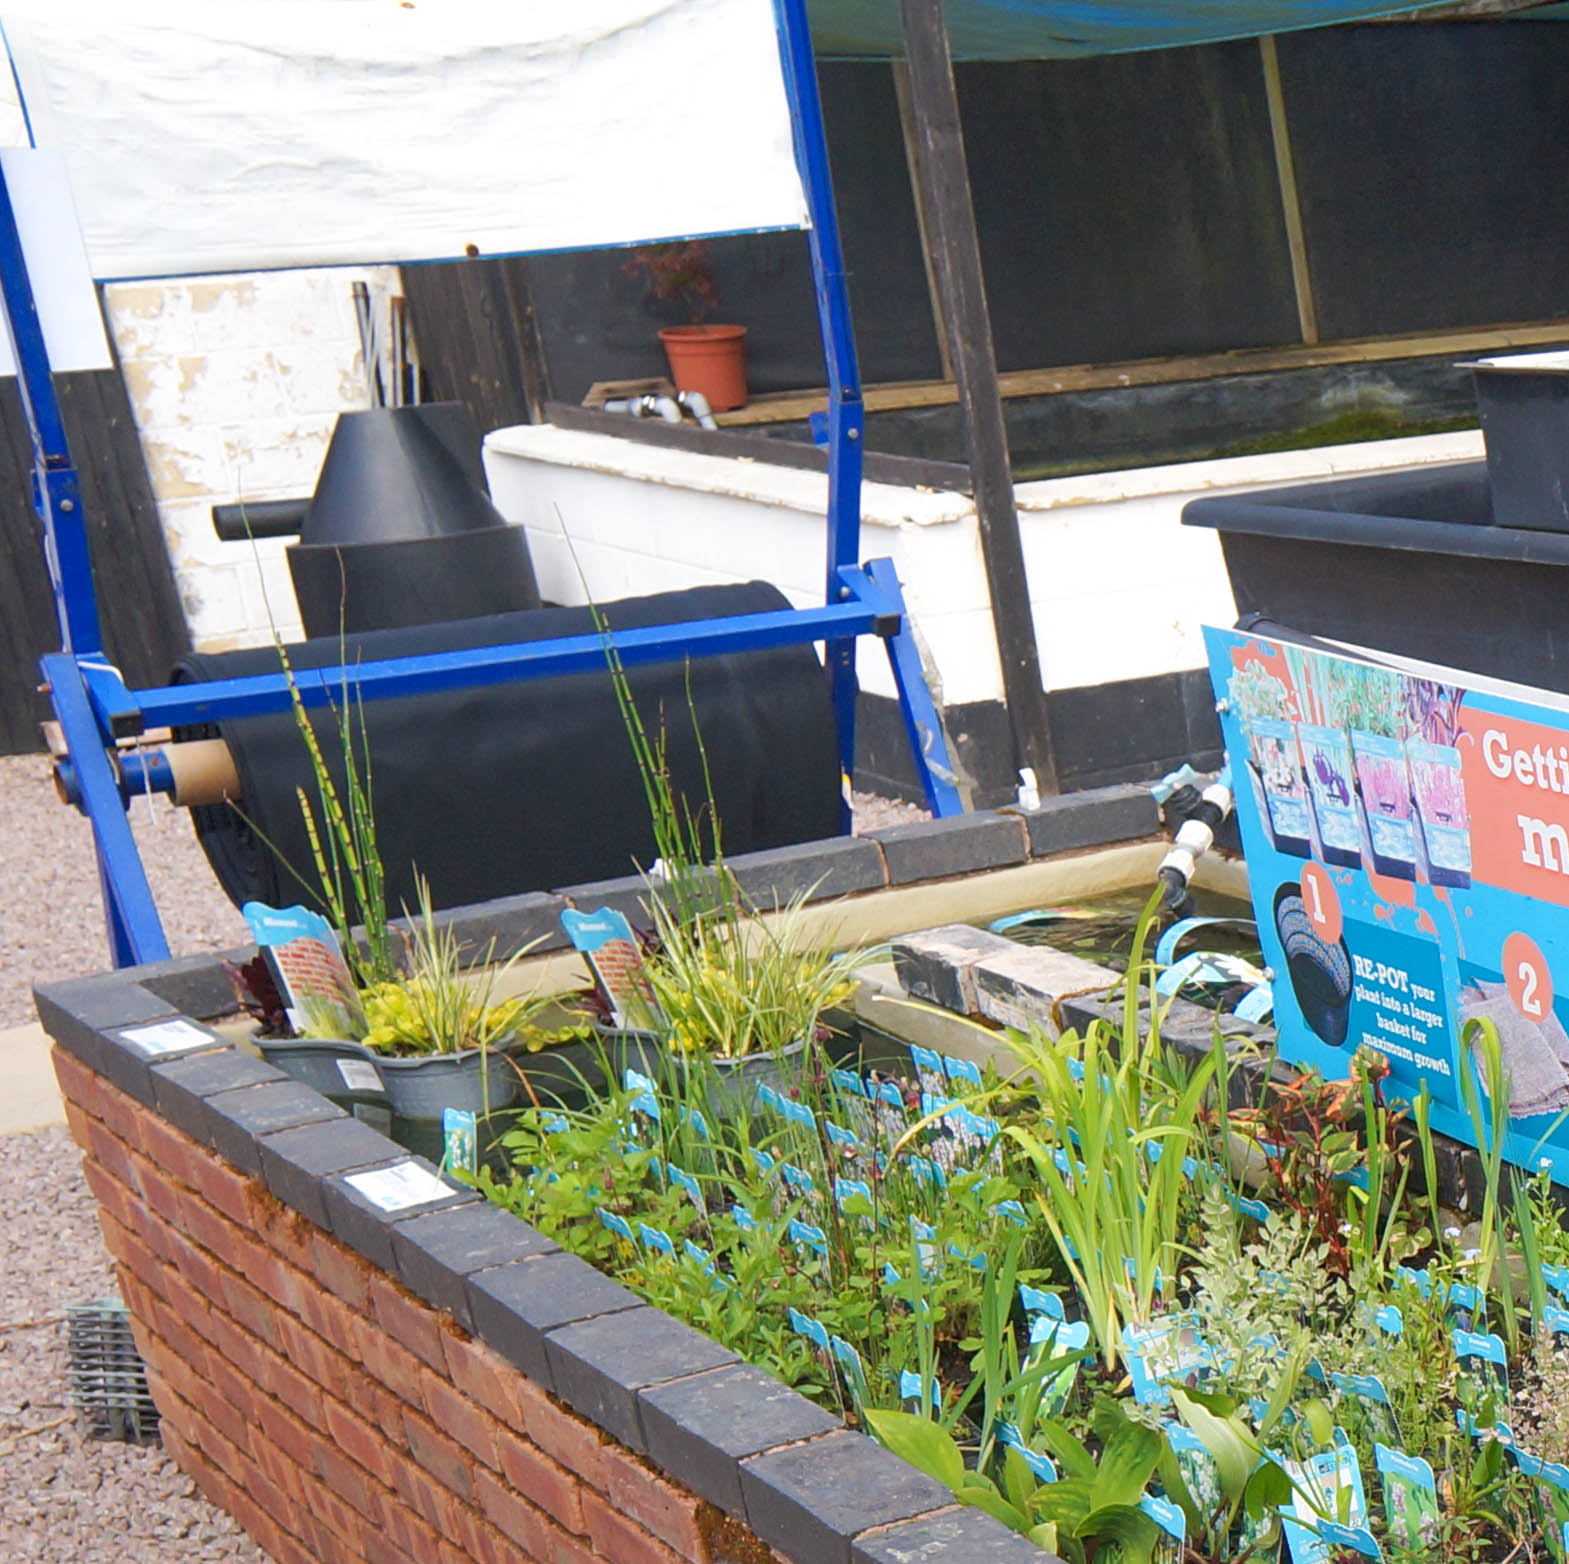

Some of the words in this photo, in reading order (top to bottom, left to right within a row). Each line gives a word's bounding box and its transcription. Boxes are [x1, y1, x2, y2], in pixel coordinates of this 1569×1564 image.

[1307, 874, 1327, 924] 1
[1352, 954, 1409, 994] RE-POT
[1410, 982, 1437, 1003] your
[1518, 962, 1542, 1016] 2
[1354, 983, 1382, 1006] plant
[1381, 991, 1402, 1014] into
[1402, 1002, 1411, 1016] a
[1410, 1001, 1444, 1029] larger
[1376, 1012, 1412, 1040] basket
[1411, 1023, 1428, 1045] for
[1361, 1031, 1414, 1063] maximum
[1414, 1050, 1451, 1076] growth
